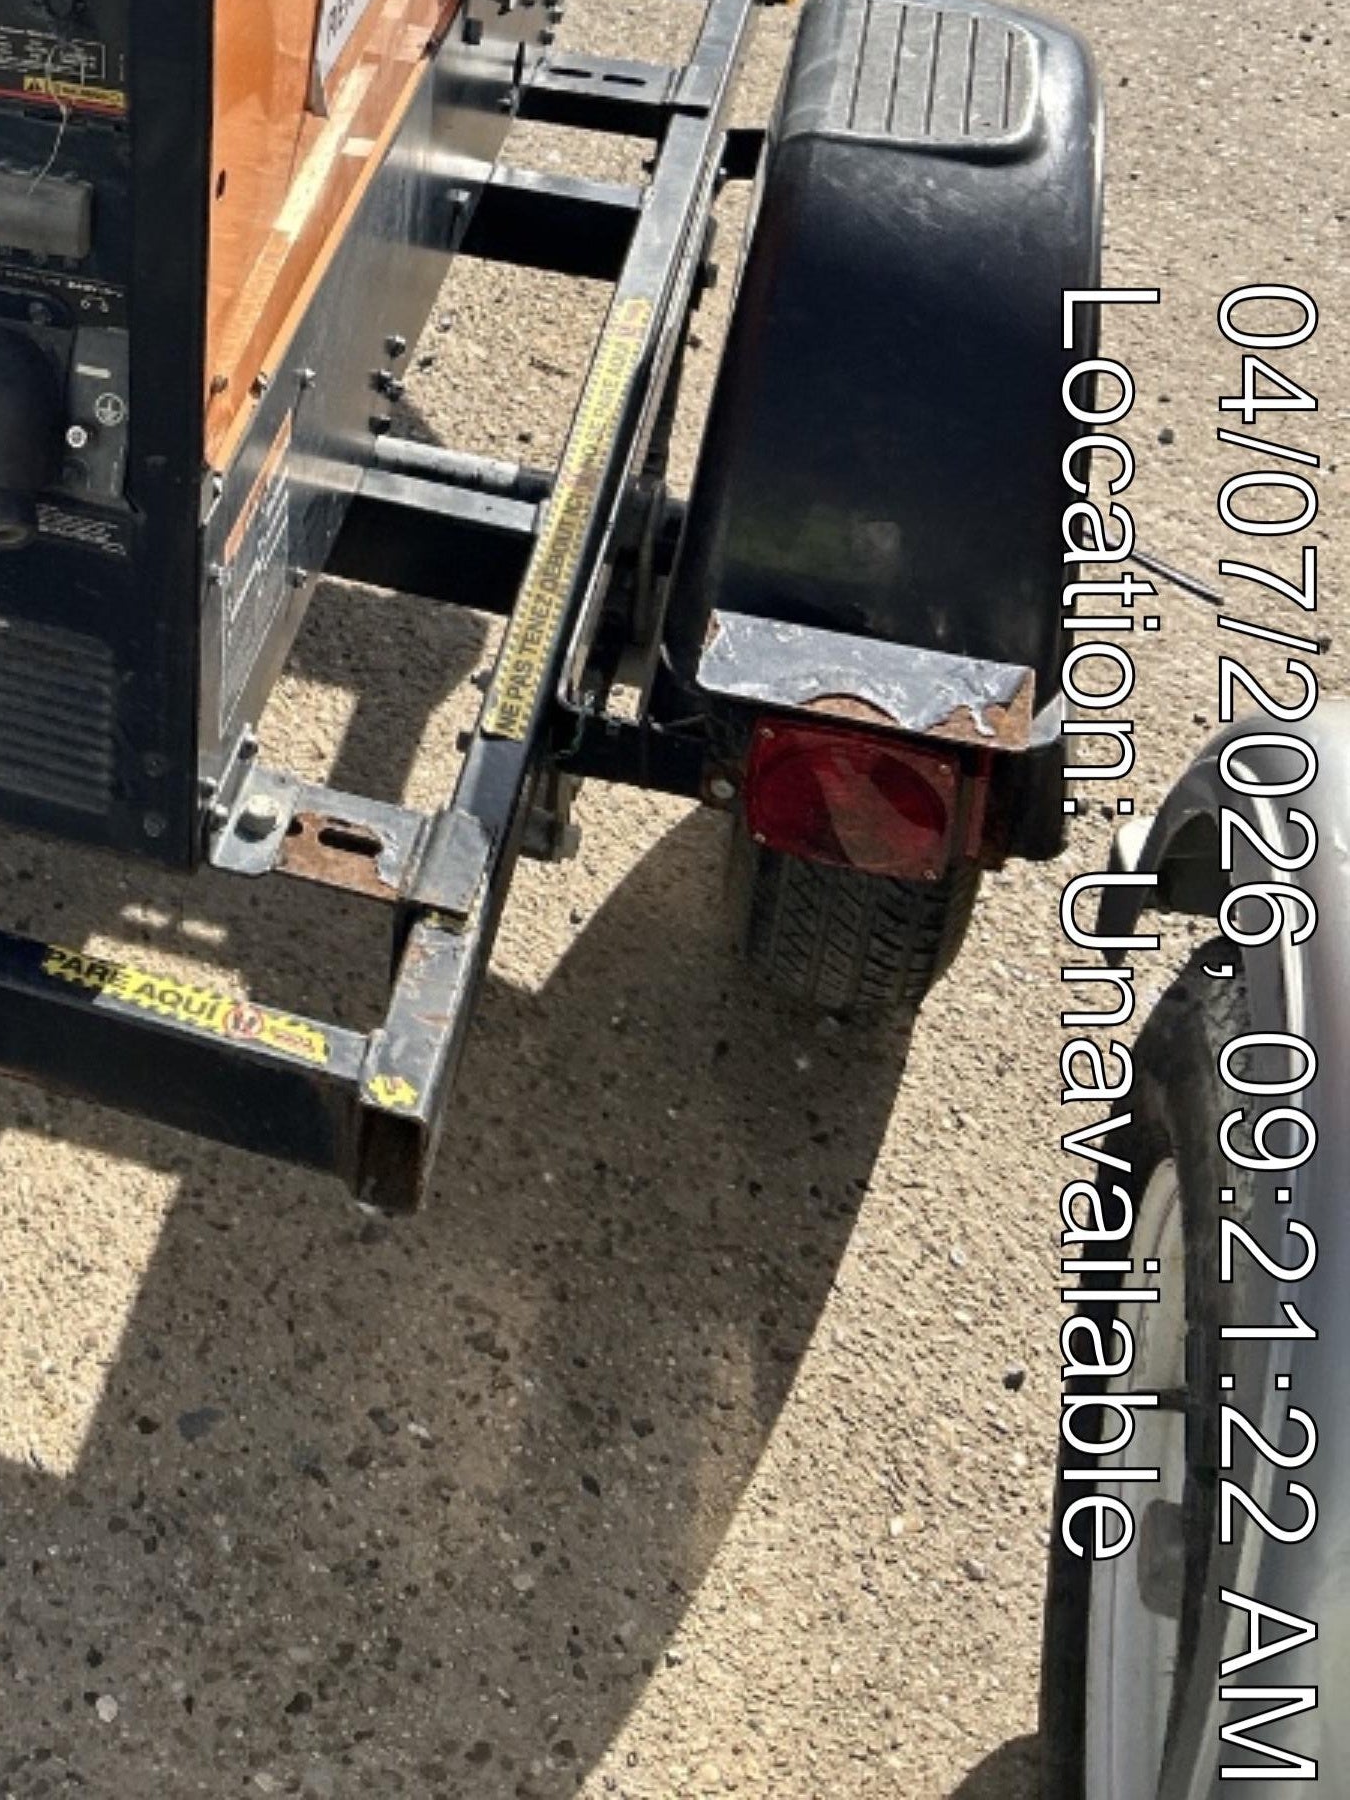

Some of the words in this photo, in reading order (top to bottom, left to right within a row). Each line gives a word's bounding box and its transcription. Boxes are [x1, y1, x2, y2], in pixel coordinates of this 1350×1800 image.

[507, 659, 534, 700] PAS
[496, 699, 520, 732] NE
[47, 949, 131, 991] PARE
